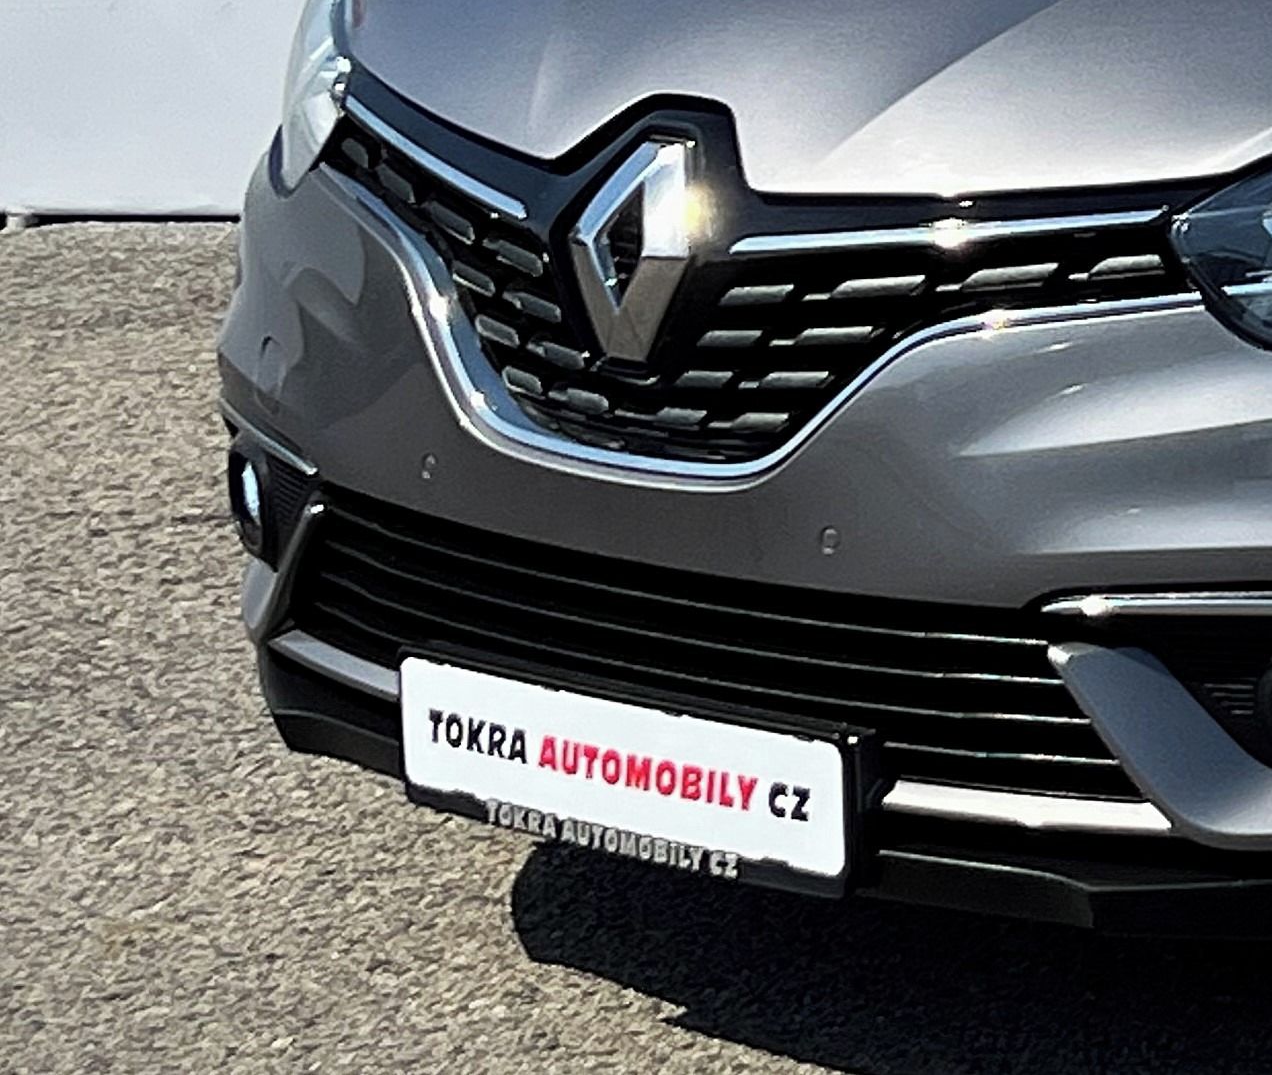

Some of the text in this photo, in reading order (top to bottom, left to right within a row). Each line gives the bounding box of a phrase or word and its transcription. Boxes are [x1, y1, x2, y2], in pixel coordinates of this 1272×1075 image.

[428, 708, 811, 821] TOKRA AUTOMOBILY CZ
[486, 800, 738, 879] TOKRA AUTOMOBILY CZ
